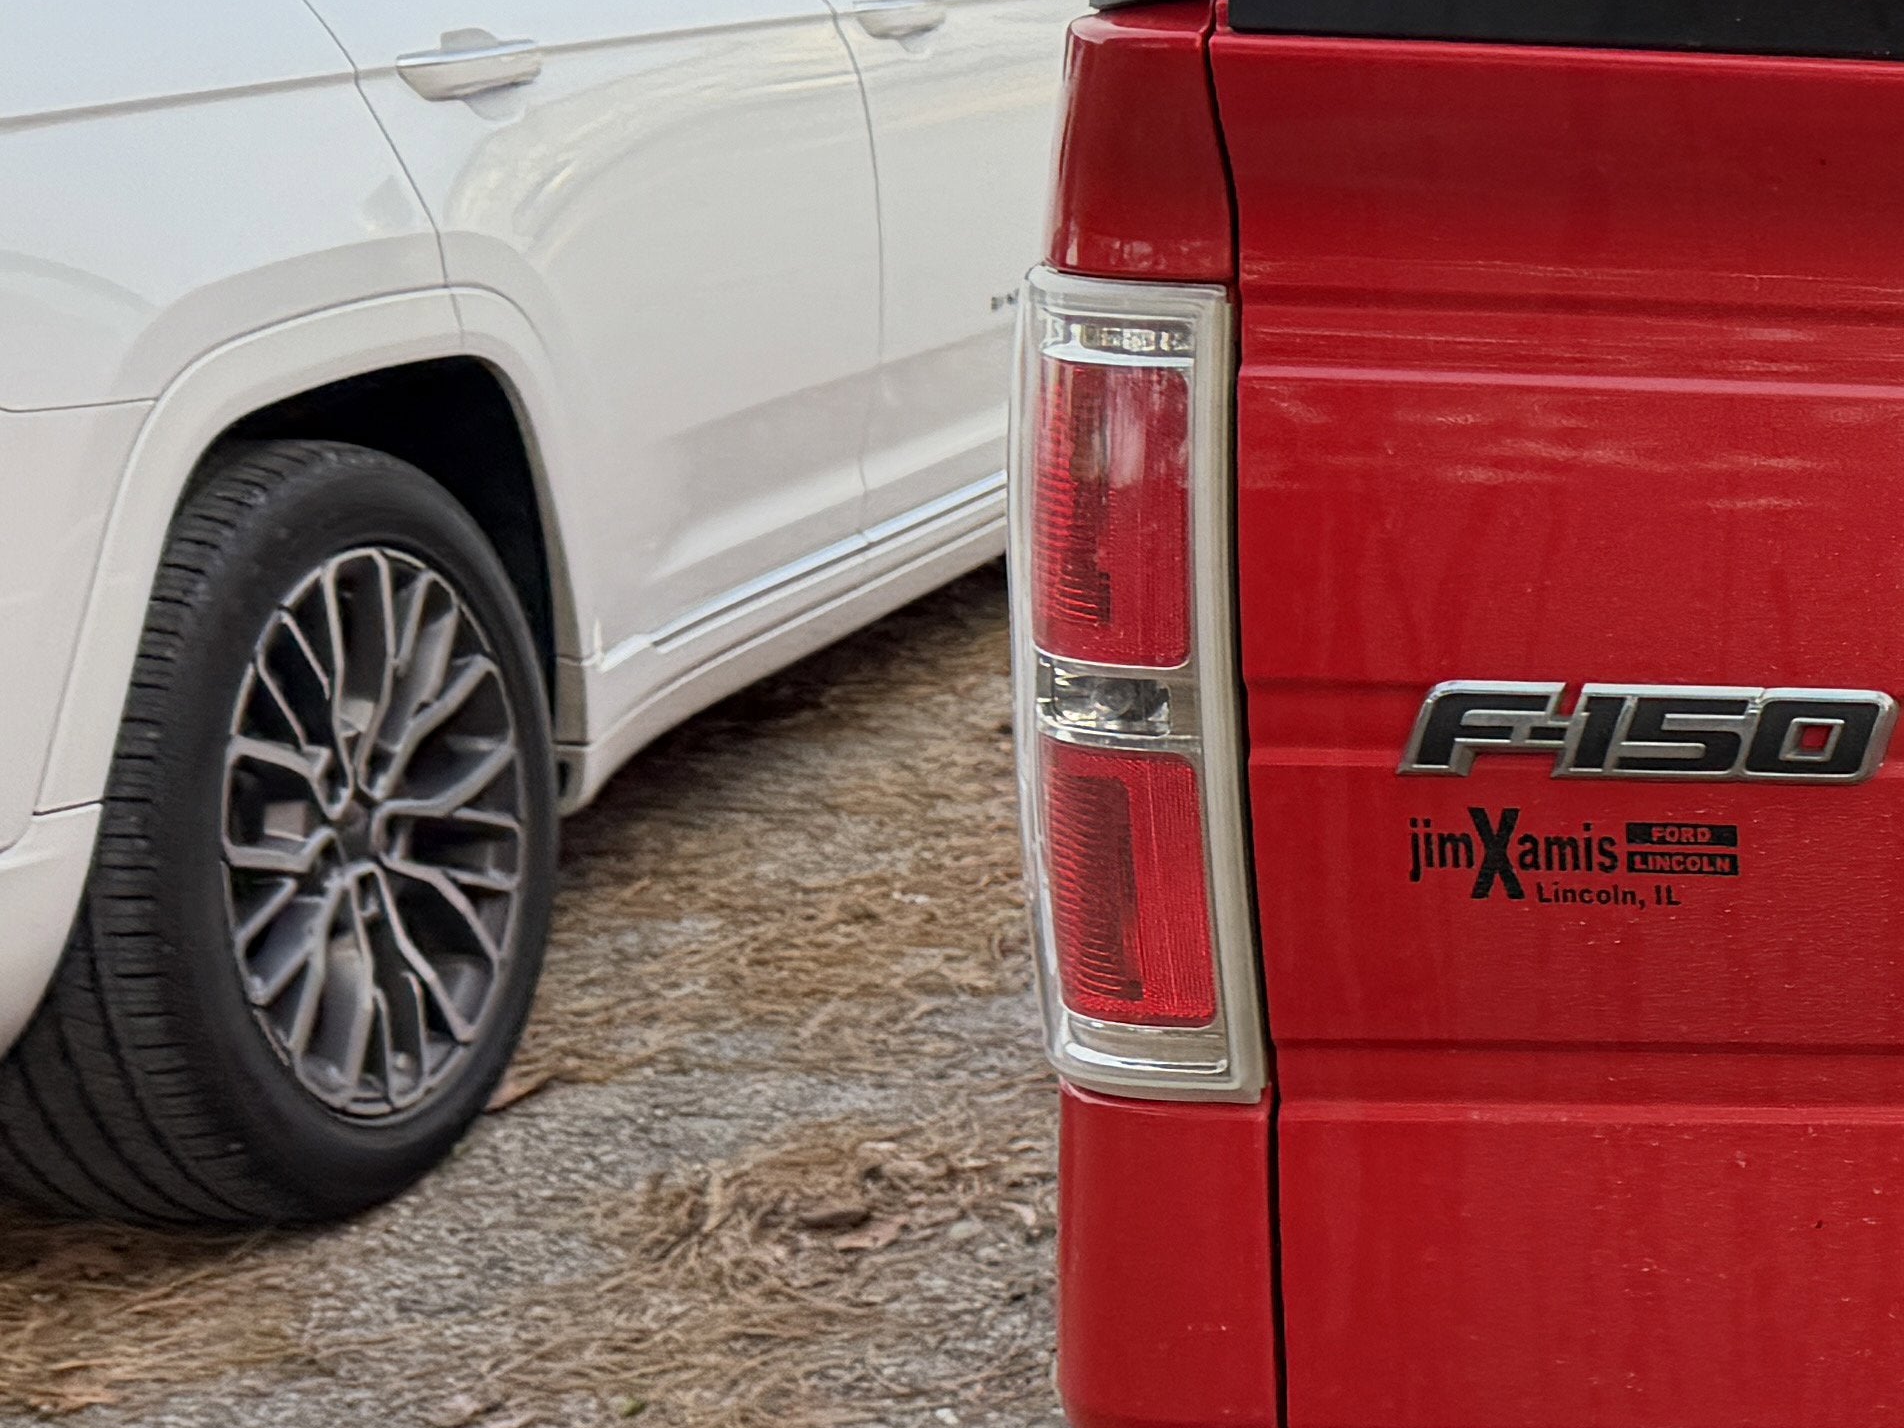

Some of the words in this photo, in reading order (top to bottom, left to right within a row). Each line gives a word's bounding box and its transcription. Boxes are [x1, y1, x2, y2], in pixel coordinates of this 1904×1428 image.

[1397, 679, 1899, 786] F-150
[1651, 827, 1712, 843] FORD
[1633, 853, 1731, 873] LINCOLN
[1536, 882, 1646, 909] Lincoln,
[1655, 884, 1682, 906] IL
